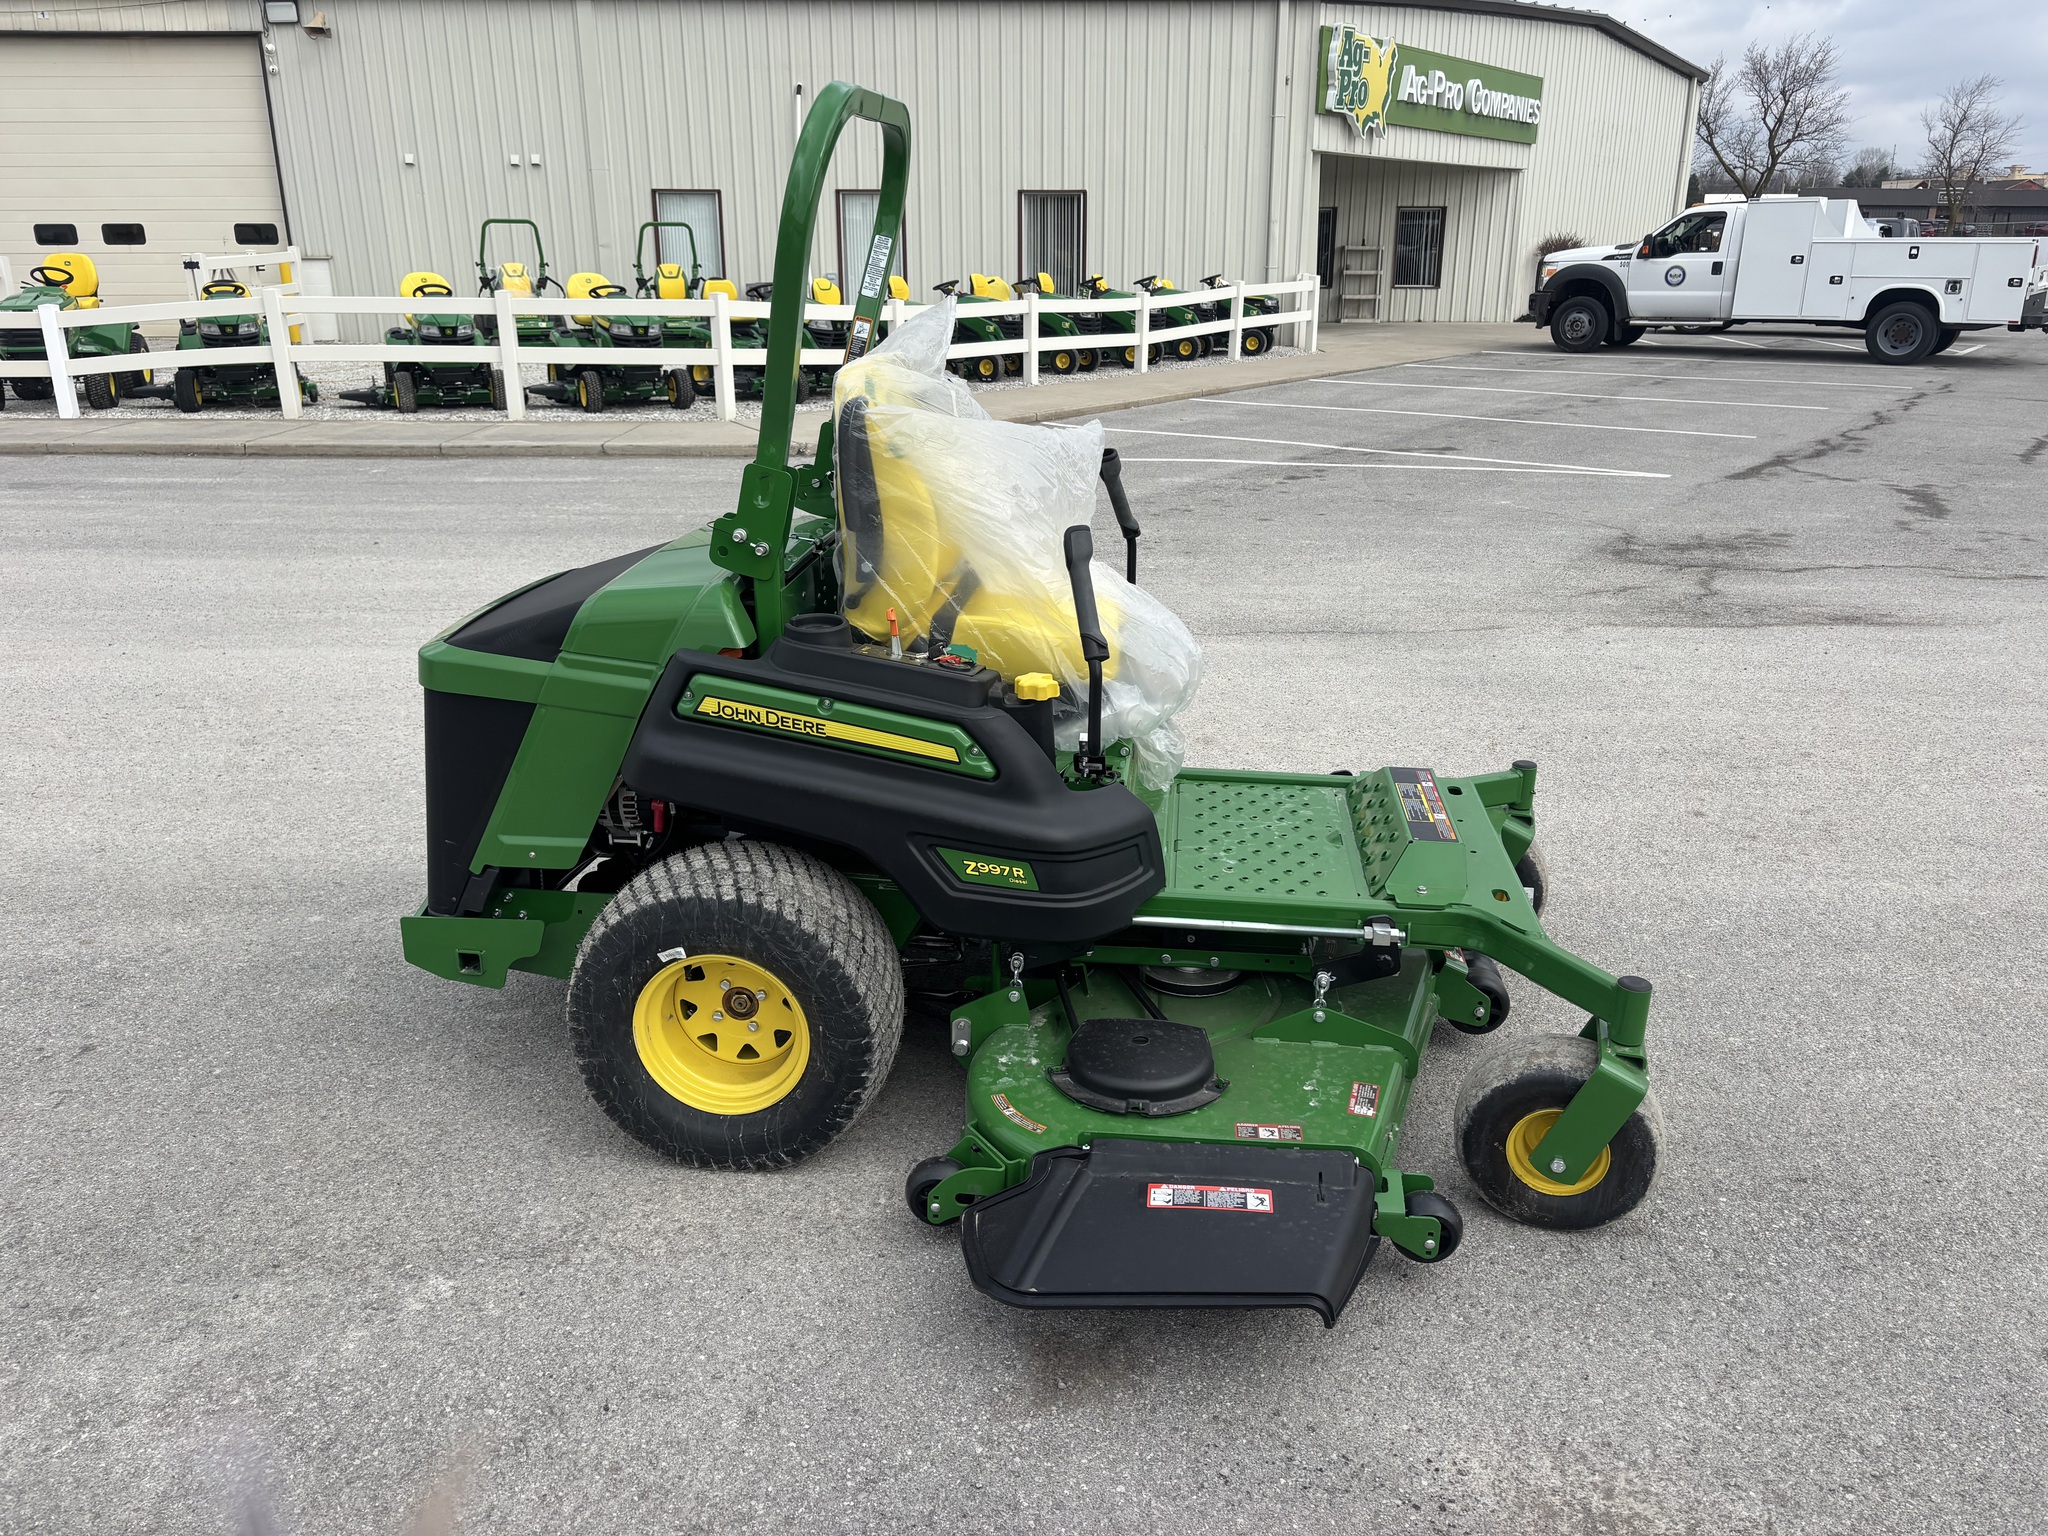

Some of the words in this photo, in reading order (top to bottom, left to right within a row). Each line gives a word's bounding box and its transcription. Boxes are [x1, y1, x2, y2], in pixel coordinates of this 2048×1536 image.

[1334, 68, 1369, 109] Pro
[1466, 78, 1541, 124] COMPANIES
[711, 700, 762, 723] JOHN
[765, 710, 827, 736] DEERE
[1008, 877, 1028, 885] Diesel
